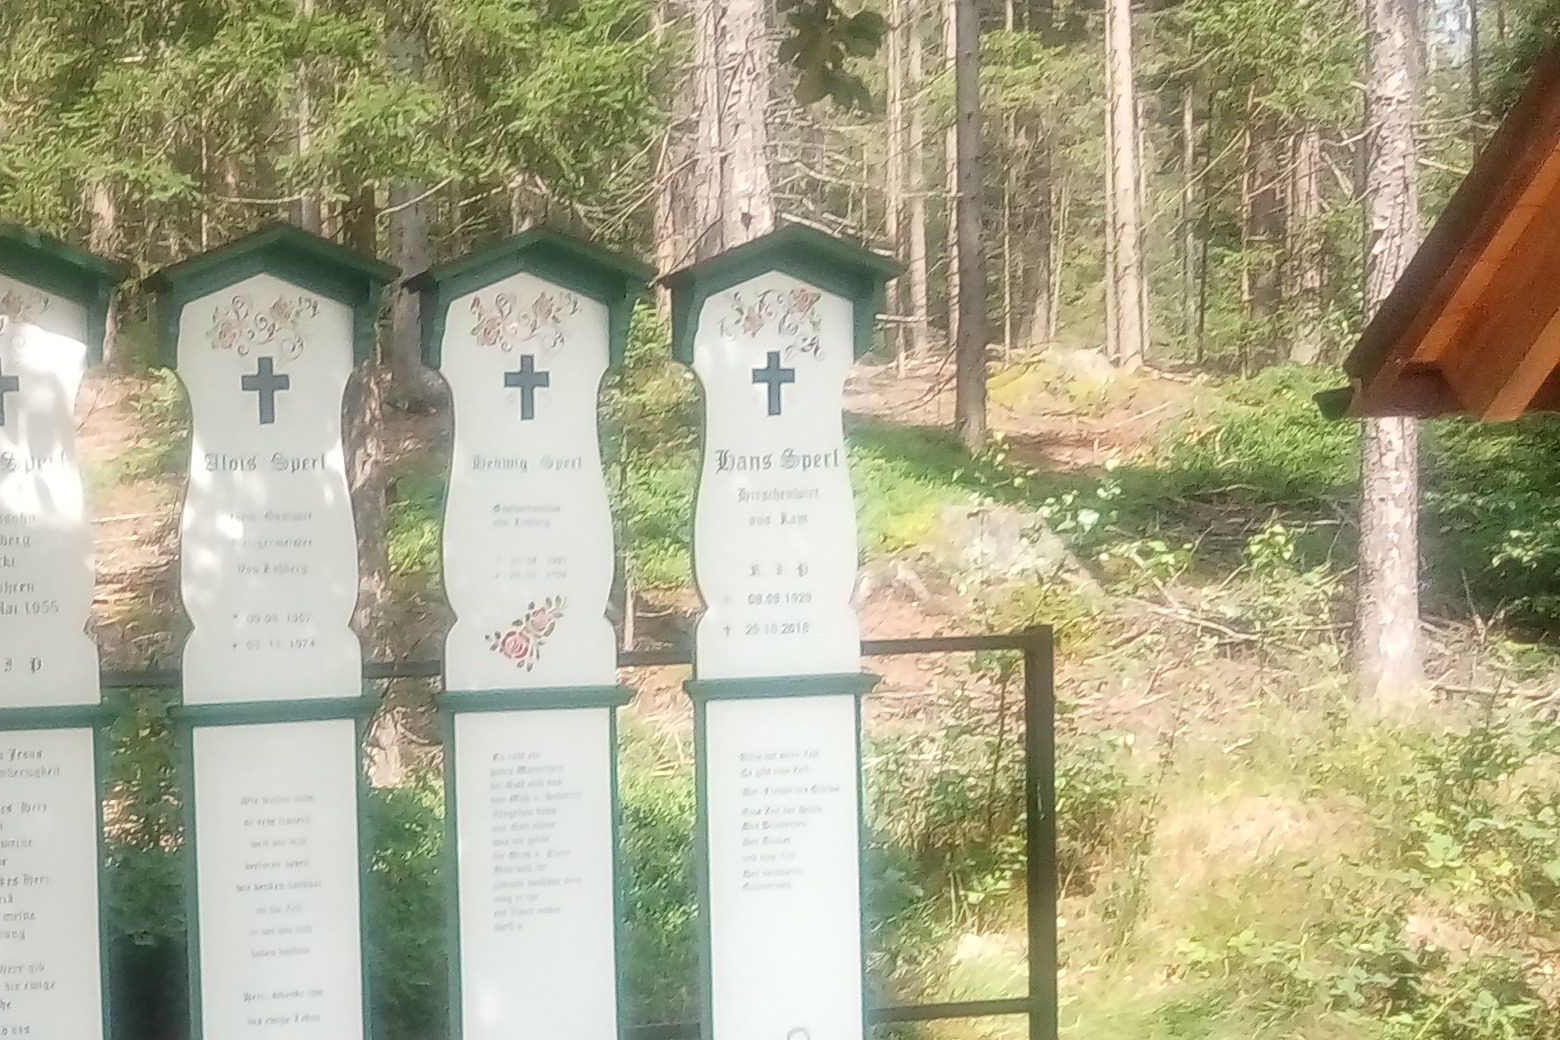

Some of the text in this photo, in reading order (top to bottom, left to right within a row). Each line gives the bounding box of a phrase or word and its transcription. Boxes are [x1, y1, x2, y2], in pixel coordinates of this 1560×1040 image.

[205, 452, 325, 473] Alois Sperl
[715, 448, 840, 474] Hans Sperl
